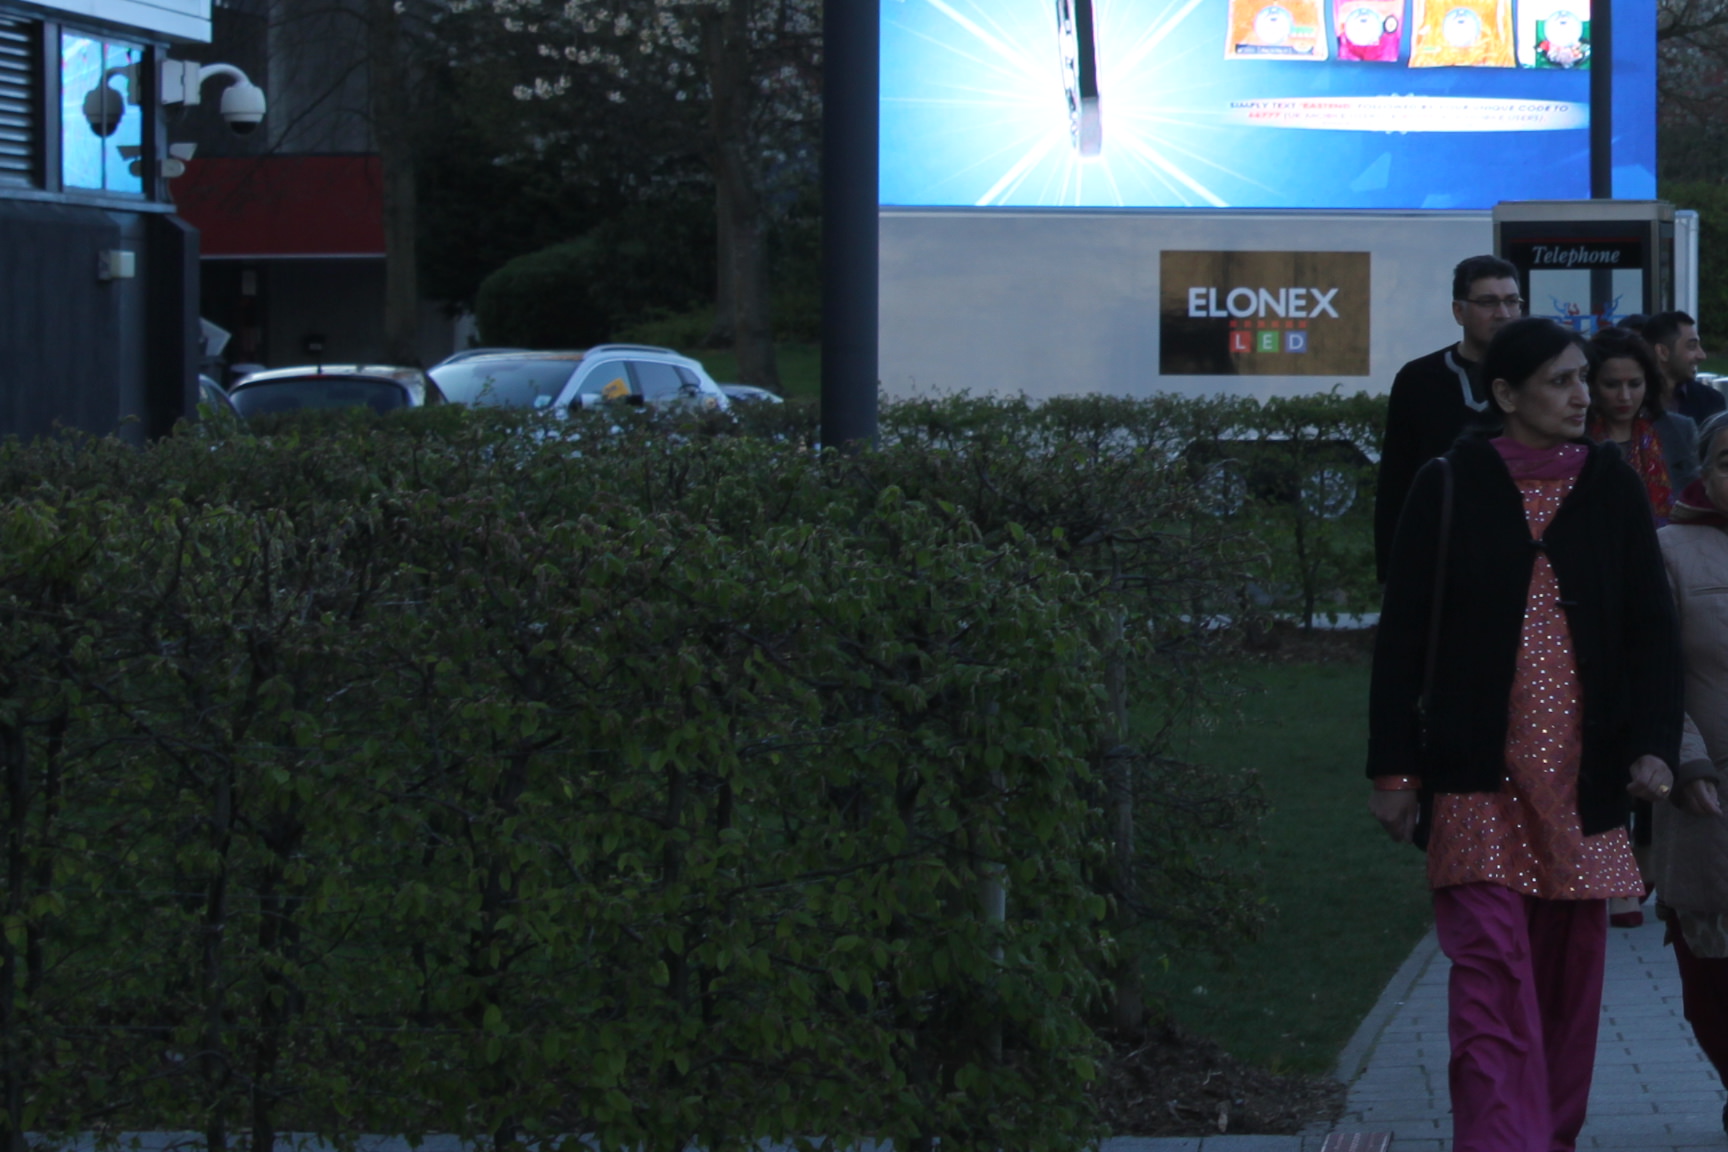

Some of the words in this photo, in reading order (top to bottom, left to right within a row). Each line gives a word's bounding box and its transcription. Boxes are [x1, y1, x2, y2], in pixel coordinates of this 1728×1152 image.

[1531, 245, 1621, 267] Telephone
[1188, 287, 1340, 319] ELONEX
[1234, 333, 1305, 350] LED
